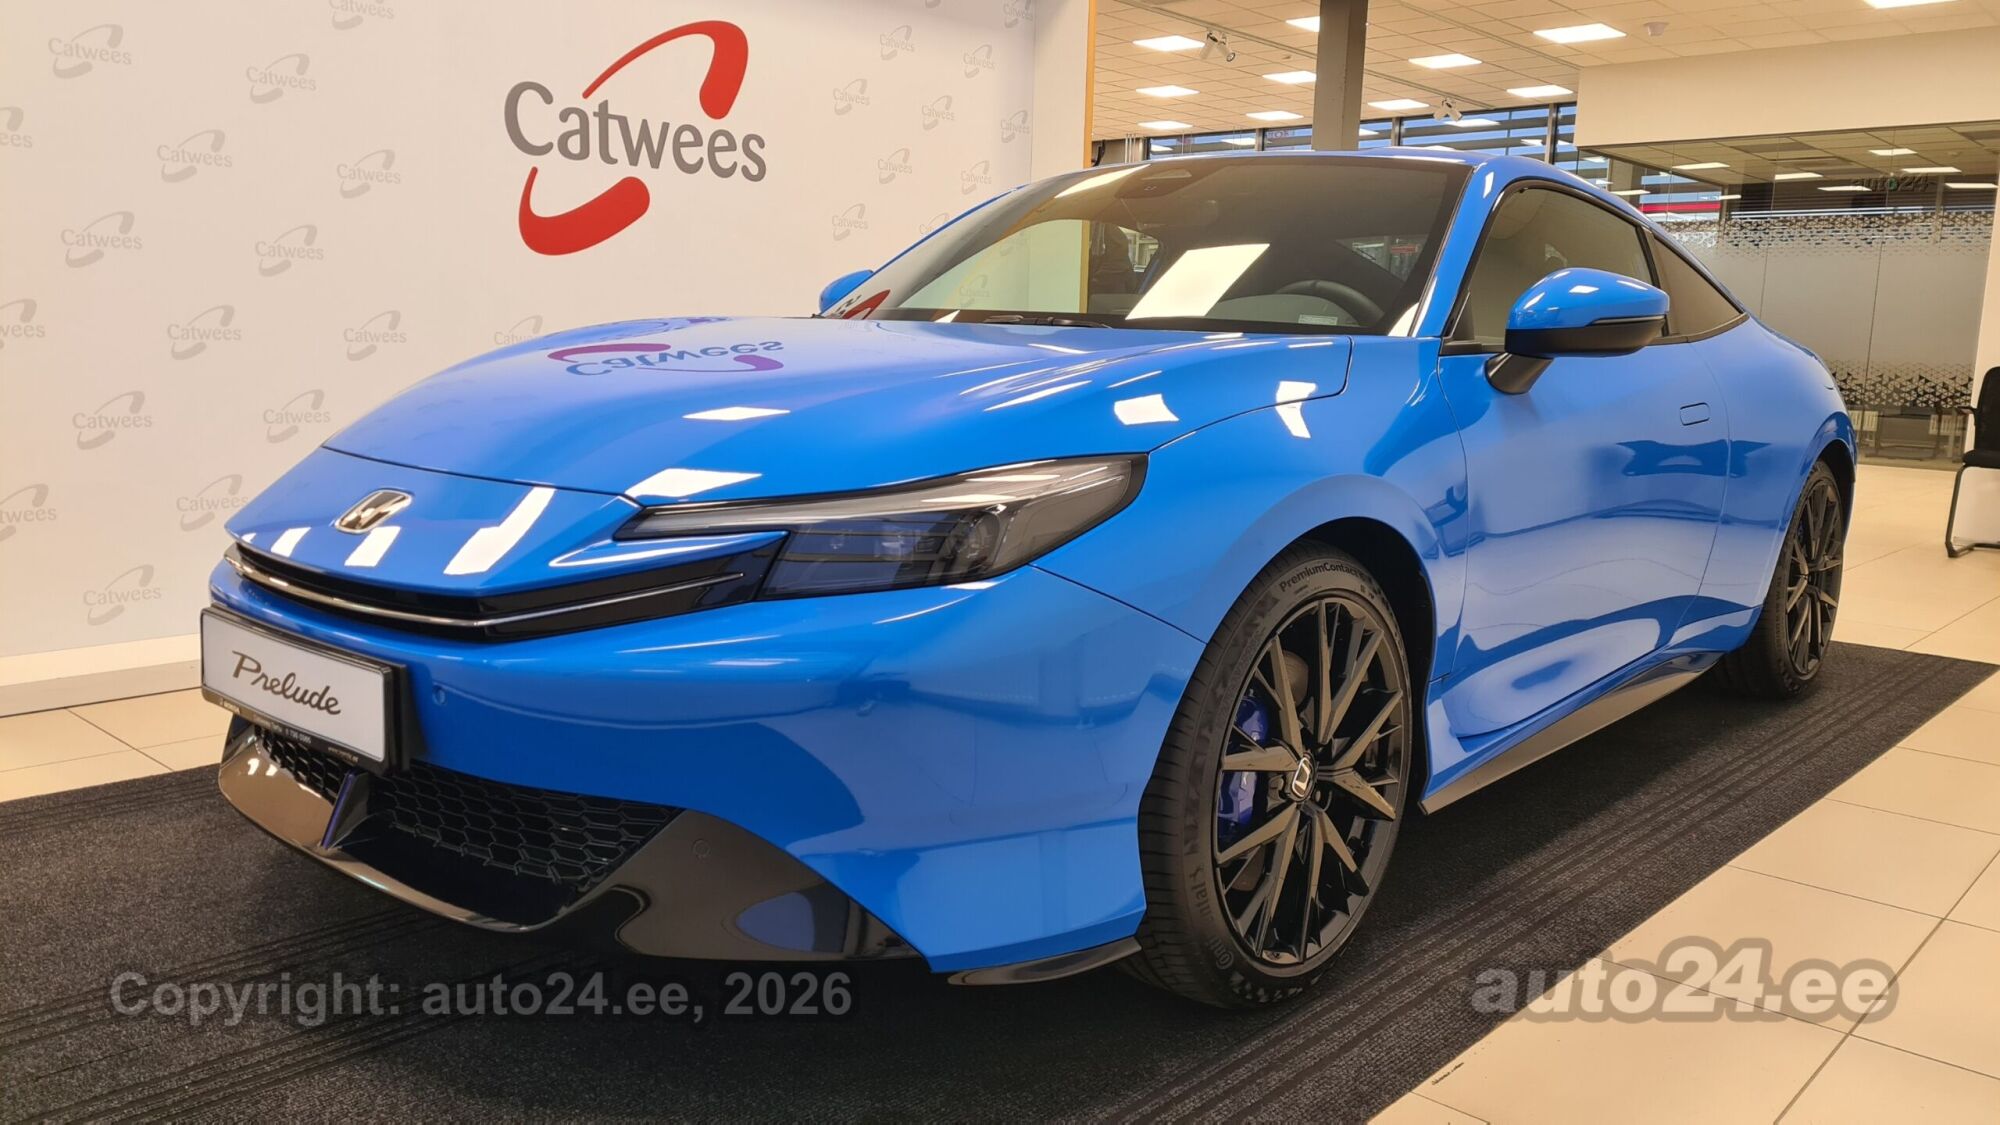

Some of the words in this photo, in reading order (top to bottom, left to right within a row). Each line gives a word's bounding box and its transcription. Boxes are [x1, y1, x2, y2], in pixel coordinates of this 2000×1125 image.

[329, 0, 394, 20] Catwees
[48, 38, 132, 65] Catwees
[880, 34, 915, 53] Catwees
[963, 52, 995, 70] Catwees
[246, 67, 316, 90] Catwees
[833, 89, 870, 105] Catwees
[921, 105, 955, 121] Catwees
[504, 81, 766, 182] Catwees
[157, 145, 232, 168] Catwees
[337, 164, 401, 185] Catwees
[877, 159, 912, 174] Catwees
[961, 170, 992, 185] Catwees
[832, 215, 868, 231] Catwees
[60, 229, 143, 250] Catwees
[255, 241, 324, 261] Catwees
[0, 323, 45, 338] wees
[168, 324, 241, 341] Catwees
[343, 328, 407, 344] Catwees
[73, 412, 152, 430] Catwees
[264, 409, 330, 424] Catwees
[177, 495, 248, 511] Catwees
[0, 507, 56, 522] twees
[83, 588, 161, 606] Catwees
[232, 650, 341, 716] Prelude
